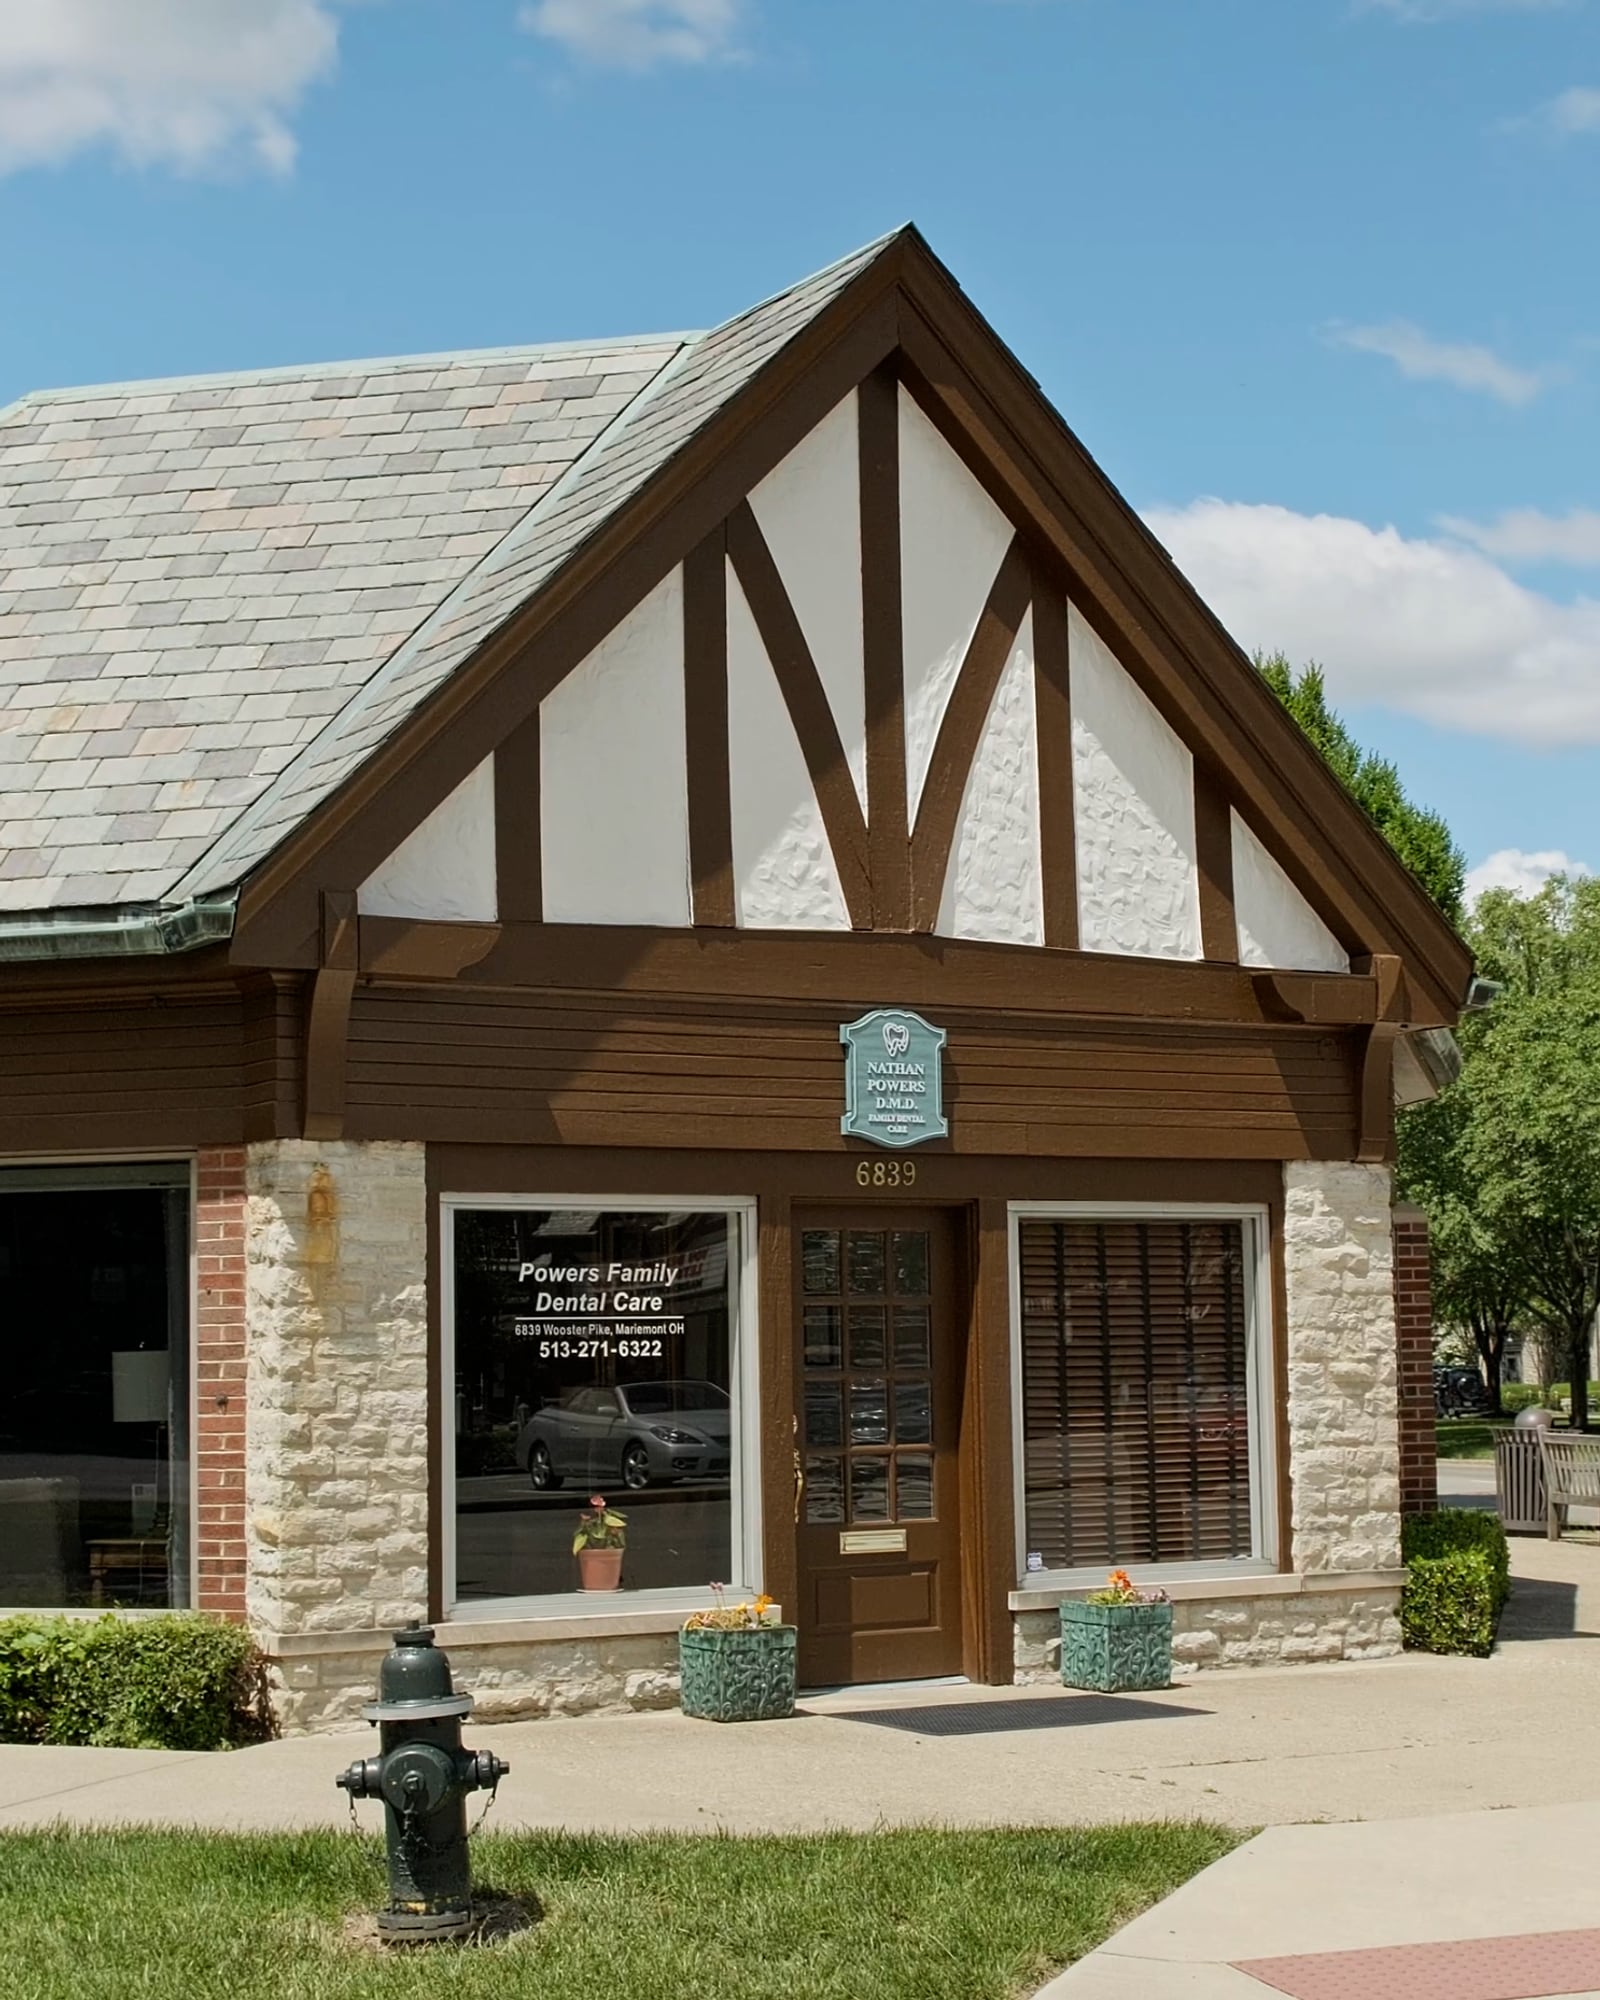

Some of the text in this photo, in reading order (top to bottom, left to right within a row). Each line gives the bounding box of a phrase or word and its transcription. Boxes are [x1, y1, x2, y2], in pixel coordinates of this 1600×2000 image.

[867, 1062, 925, 1075] NATHAN
[867, 1079, 926, 1093] POWERS
[876, 1097, 918, 1110] D.M.D.
[856, 1161, 916, 1187] 6839
[518, 1262, 600, 1282] Powers
[606, 1262, 679, 1287] Family
[535, 1291, 663, 1312] Dental Care
[514, 1322, 685, 1336] 6839 Wooster Pike, Mariemont OH
[539, 1340, 662, 1358] 513-271-6322
